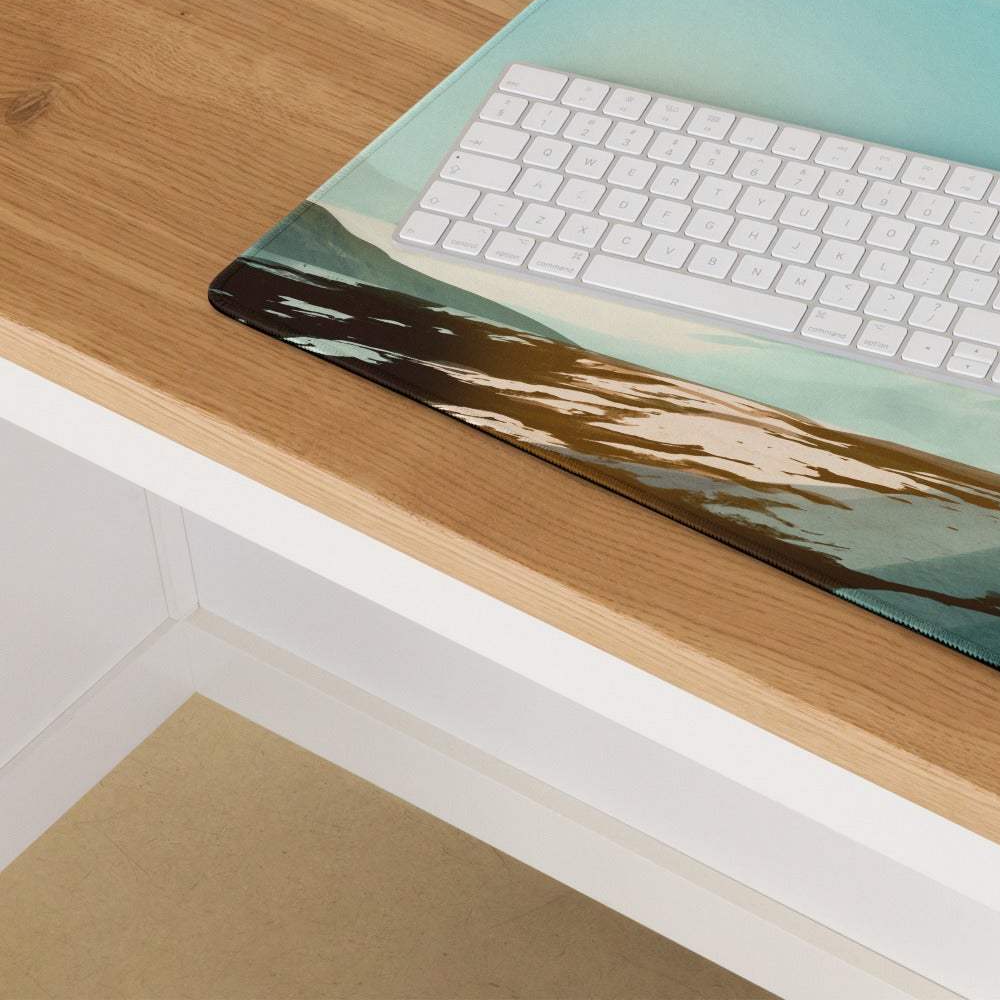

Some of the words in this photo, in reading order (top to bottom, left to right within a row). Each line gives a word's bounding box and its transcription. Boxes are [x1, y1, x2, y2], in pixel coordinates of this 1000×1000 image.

[585, 158, 598, 166] W
[670, 178, 679, 187] R
[619, 200, 629, 208] D
[662, 210, 672, 218] F
[800, 208, 809, 216] U
[579, 225, 589, 234] X
[748, 231, 759, 240] H
[622, 236, 631, 245] C
[835, 251, 843, 260] K
[752, 267, 762, 277] N
[794, 277, 807, 287] M
